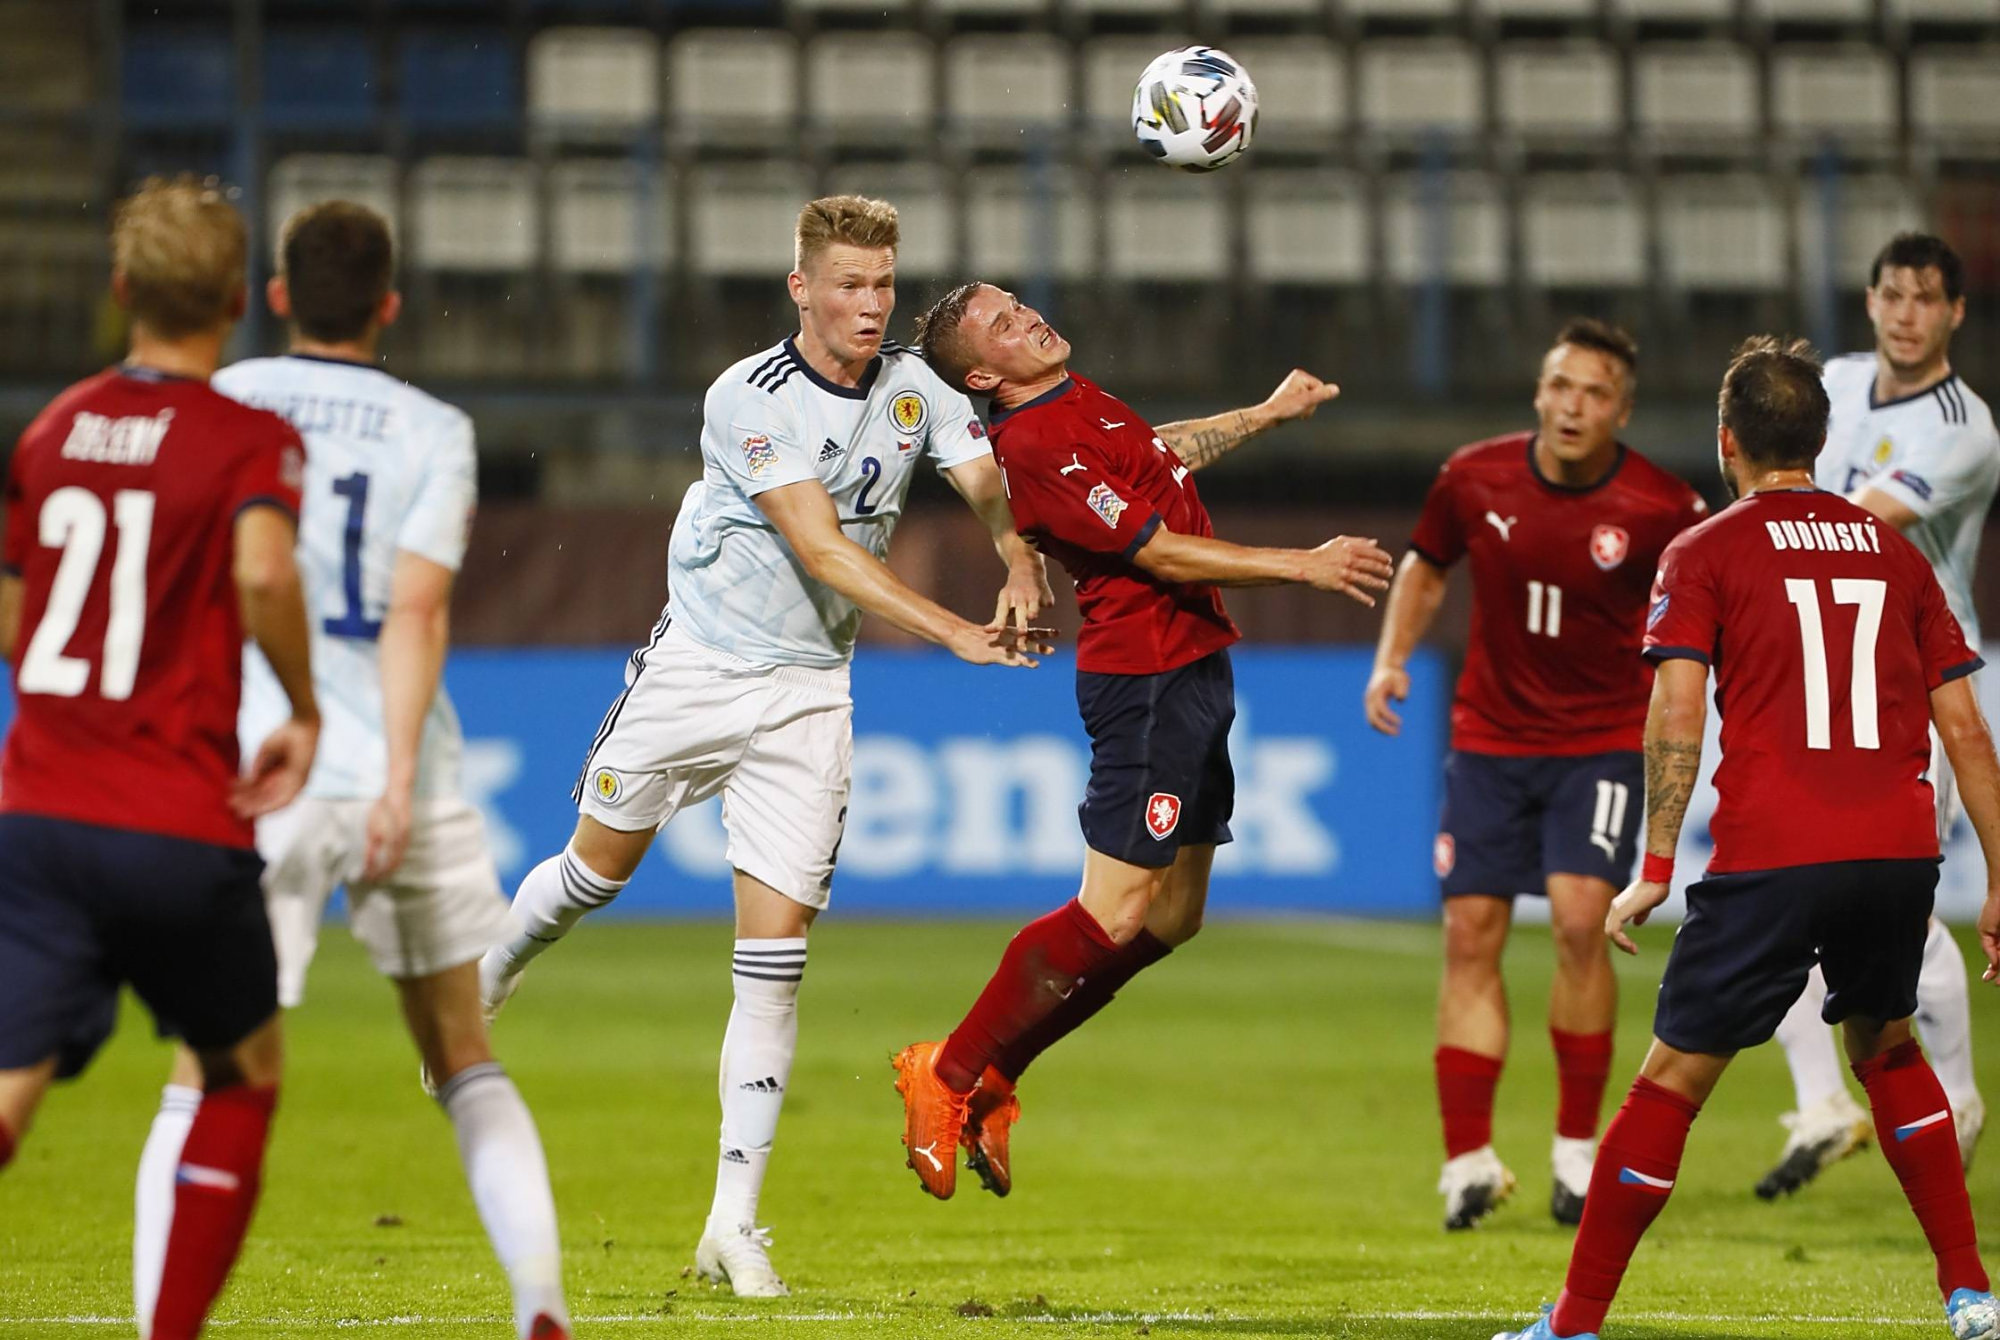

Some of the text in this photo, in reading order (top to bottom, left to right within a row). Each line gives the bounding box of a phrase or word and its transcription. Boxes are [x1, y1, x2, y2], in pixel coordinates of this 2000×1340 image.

[855, 456, 881, 515] 2
[1765, 512, 1880, 554] BUDÍNSKÝ
[19, 486, 156, 701] 21
[1527, 581, 1562, 638] 11
[1785, 578, 1886, 750] 17
[1592, 780, 1628, 838] 11
